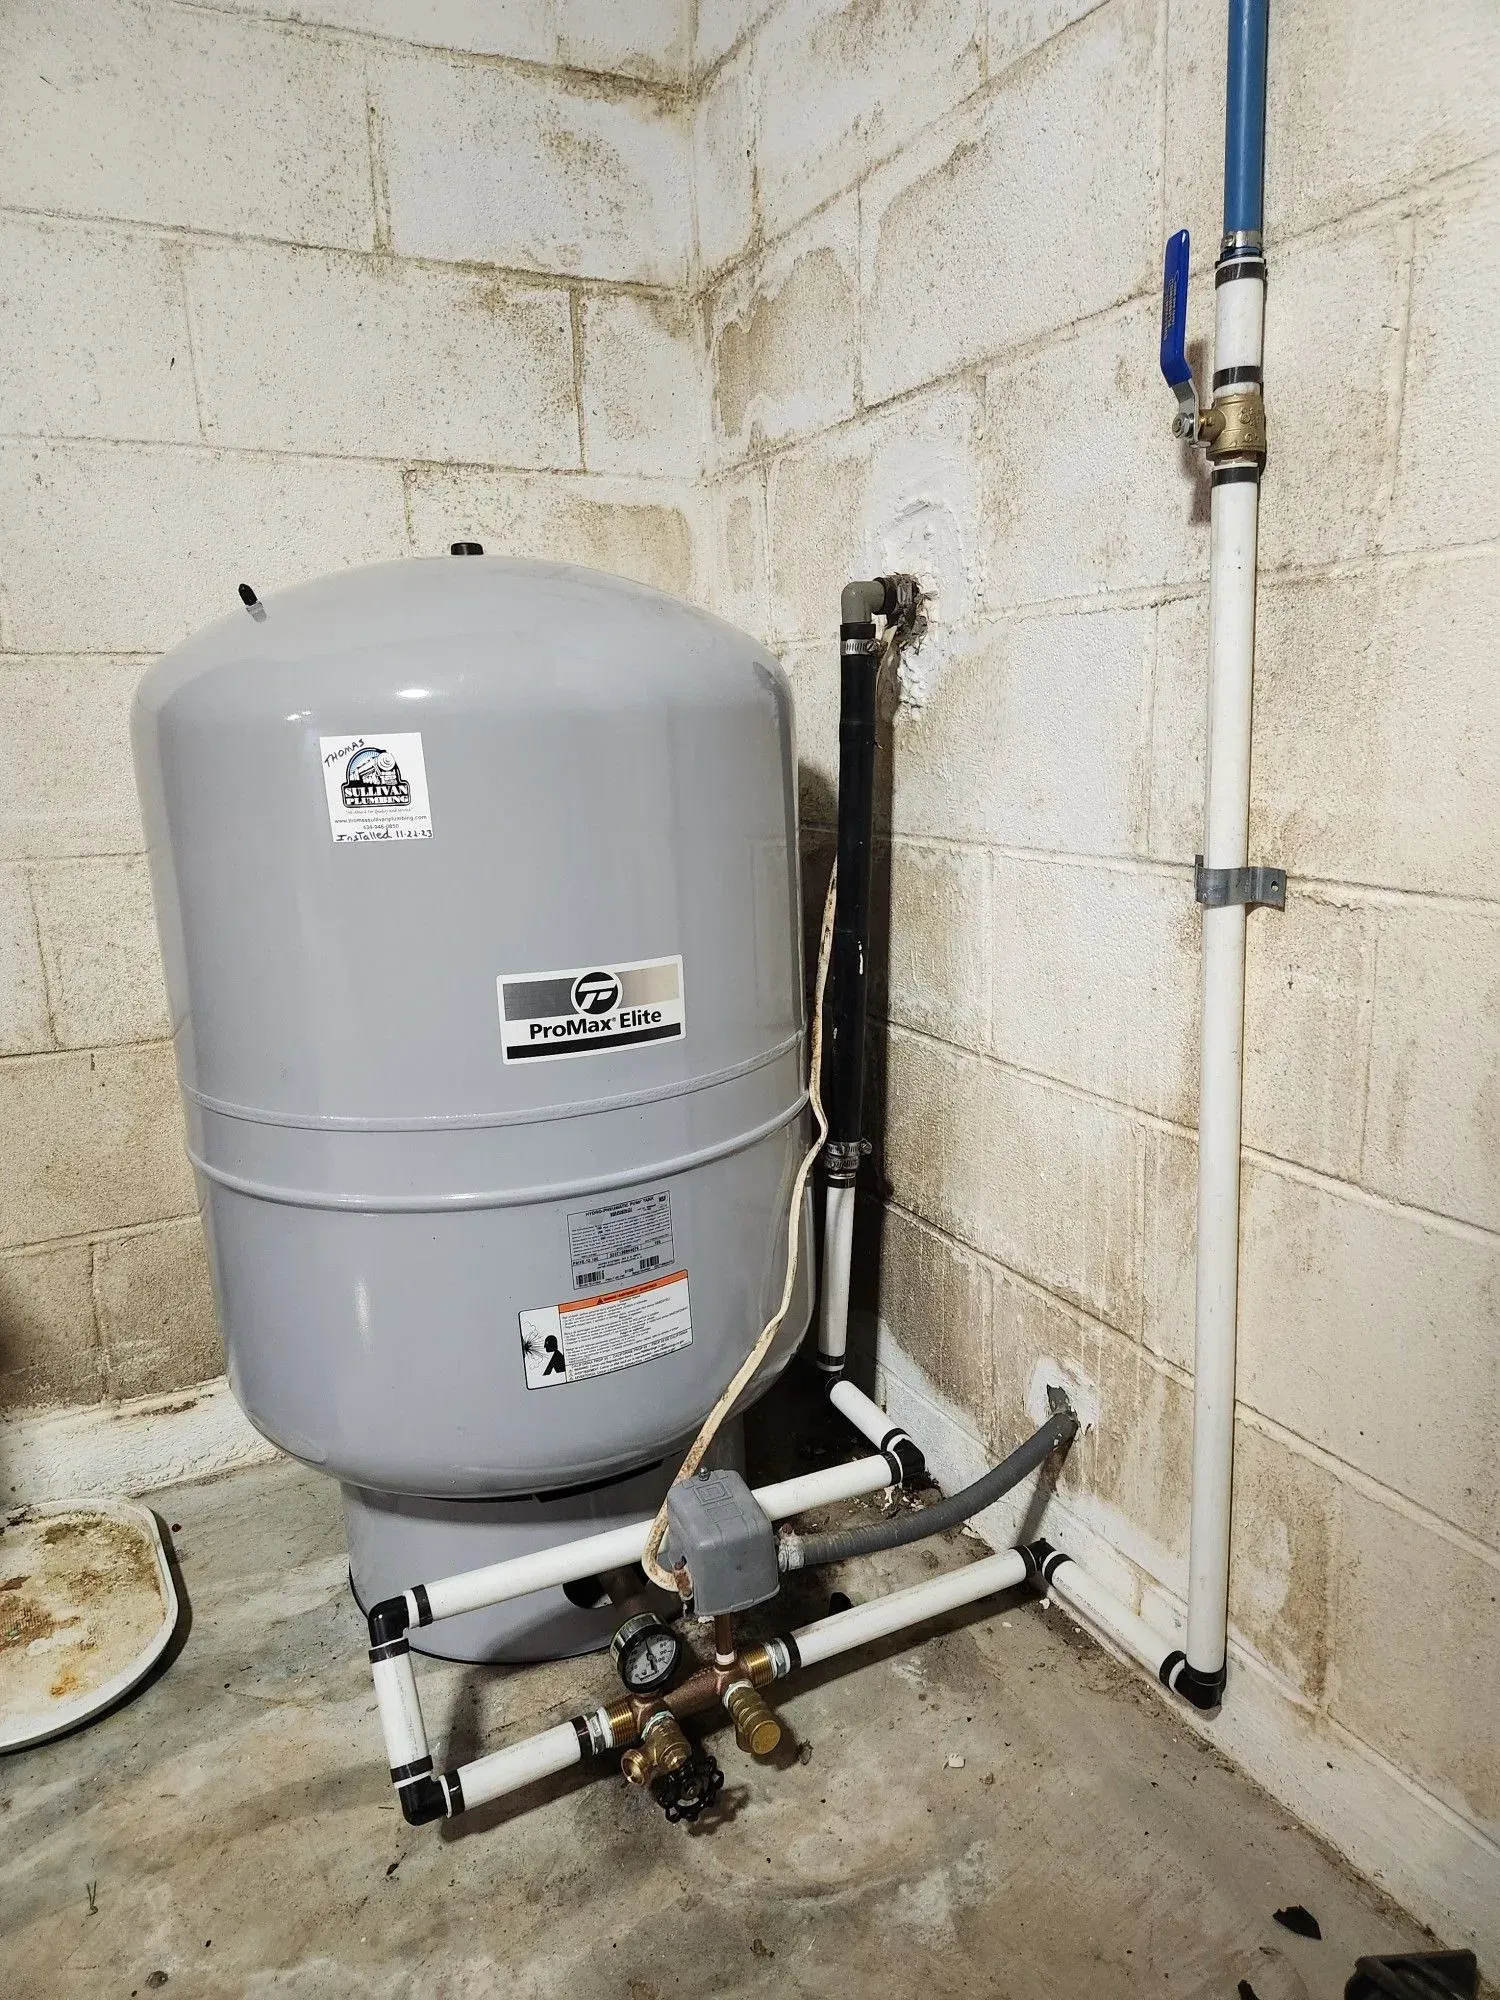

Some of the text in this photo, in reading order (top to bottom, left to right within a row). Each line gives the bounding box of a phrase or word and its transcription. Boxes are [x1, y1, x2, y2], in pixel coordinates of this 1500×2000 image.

[324, 739, 365, 767] THOMAS
[344, 785, 408, 798] SULLIVAN
[346, 796, 409, 805] PLUMBING
[619, 1009, 662, 1029] Elite
